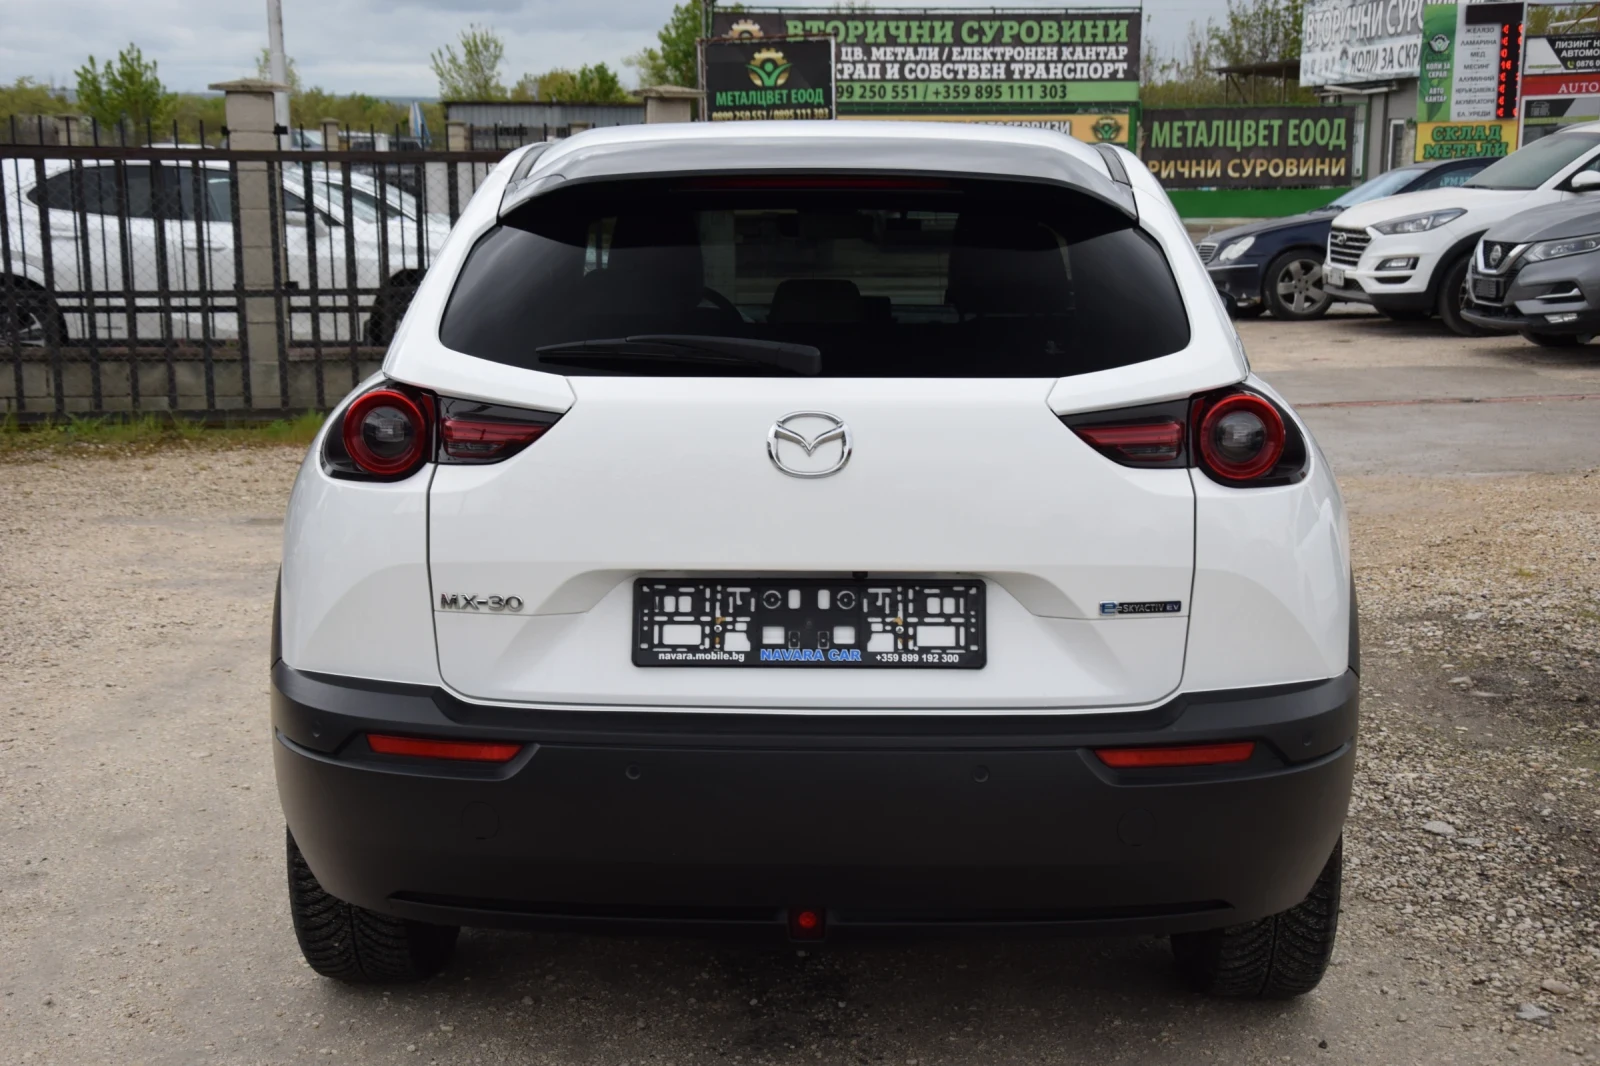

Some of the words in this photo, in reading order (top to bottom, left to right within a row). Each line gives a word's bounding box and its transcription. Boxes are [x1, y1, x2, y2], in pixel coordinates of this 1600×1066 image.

[786, 20, 954, 44] ВТОРИЧНИ
[961, 20, 1129, 44] СУРОВИНИ
[1306, 1, 1384, 46] ВТОРИЧНИ
[1555, 40, 1592, 49] ЛИЗИНГ
[841, 46, 867, 62] ЦВ.
[871, 46, 939, 61] МЕТАЛИ
[952, 46, 1058, 61] ЕЛЕКТРОНЕН
[1061, 46, 1128, 61] КАНТАР
[1397, 43, 1420, 67] СКР
[885, 63, 900, 79] И
[904, 63, 1006, 79] СОБСТВЕН
[1011, 63, 1128, 79] ТРАНСПОРТ
[859, 85, 886, 99] 250
[891, 85, 918, 99] 551
[933, 85, 970, 99] +359
[975, 85, 1002, 99] 895
[1008, 85, 1034, 99] 111
[1039, 85, 1067, 99] 303
[1557, 82, 1599, 94] AUTO
[715, 90, 788, 107] МЕТАЛЦВЕТ
[791, 88, 825, 105] ЕООД
[1151, 119, 1282, 151] МЕТАЛЦВЕТ
[1288, 118, 1346, 150] ЕООД
[1432, 125, 1502, 142] СКЛАД
[1423, 142, 1508, 159] МЕТАЛИ
[1227, 157, 1346, 178] СУРОВИНИ
[440, 592, 524, 612] MX-30
[658, 651, 745, 662] navara.mobile.bg
[760, 648, 825, 661] NAVARA
[828, 648, 862, 661] CAR
[876, 653, 899, 662] +359
[901, 653, 919, 662] 899
[921, 653, 939, 662] 192
[941, 653, 959, 662] 300
